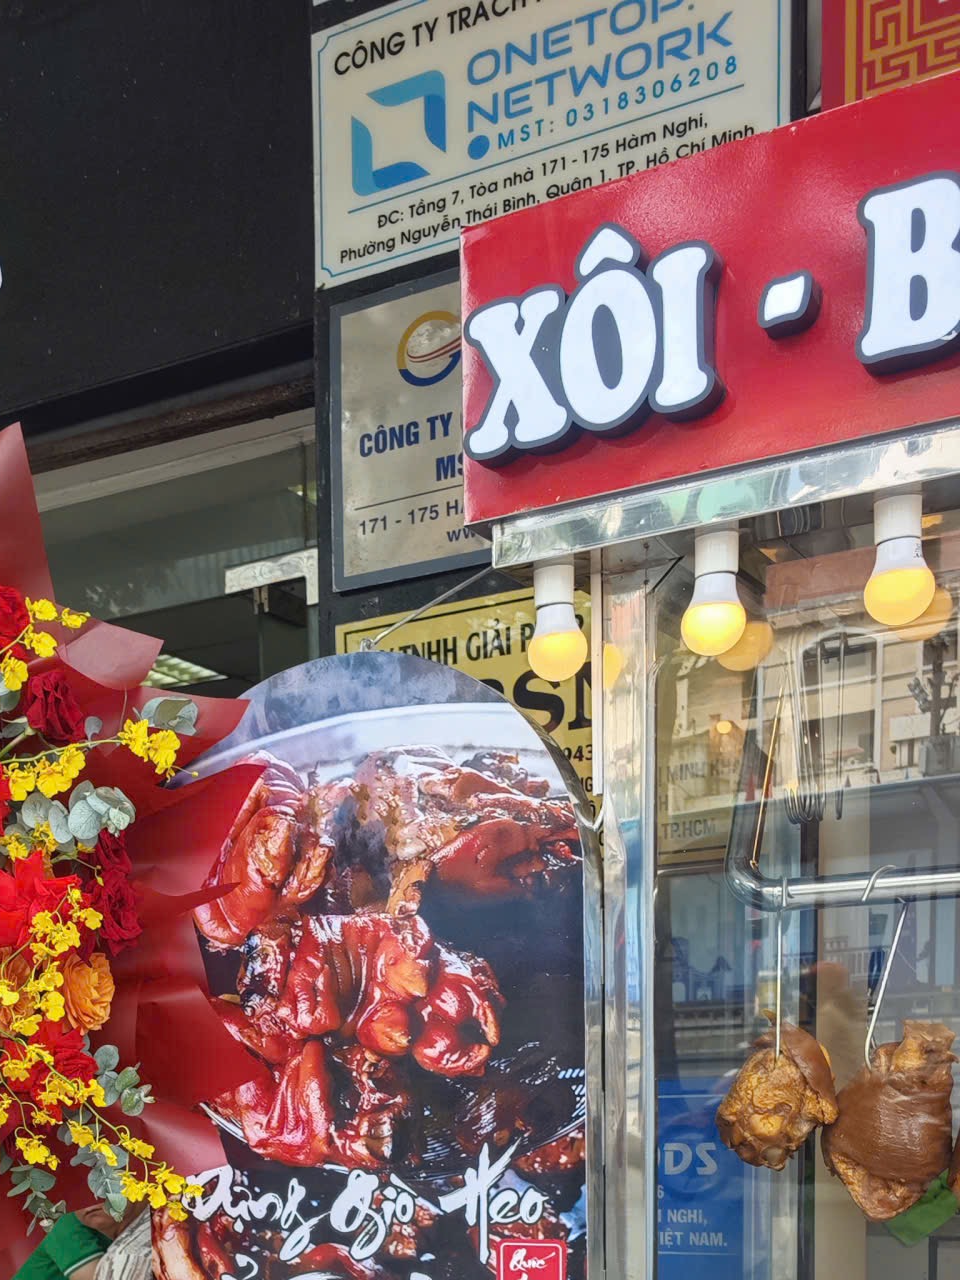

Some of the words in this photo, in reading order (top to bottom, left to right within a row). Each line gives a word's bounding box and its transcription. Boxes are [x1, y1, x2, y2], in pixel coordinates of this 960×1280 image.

[334, 31, 406, 76] CÔNG
[412, 17, 439, 48] TY
[467, 11, 733, 133] NETWORK
[566, 56, 738, 127] 0318306208
[339, 236, 396, 264] Phường
[400, 214, 461, 245] Nguyễn
[465, 206, 498, 226] Thái
[646, 147, 670, 170] Hồ
[676, 138, 707, 159] Chí
[711, 124, 755, 148] Minh
[377, 210, 404, 228] ĐC:
[408, 198, 447, 218] Tầng
[452, 190, 464, 205] 7,
[469, 181, 498, 199] Tòa
[503, 167, 534, 189] nhà
[541, 156, 566, 177] 171
[582, 142, 610, 164] 175
[615, 131, 657, 154] Hàm
[662, 112, 708, 140] Nghi,
[465, 223, 716, 464] XÔI
[359, 420, 420, 458] CÔNG
[426, 411, 453, 441] TY
[359, 515, 388, 535] 171
[407, 504, 439, 525] 175
[466, 618, 513, 662] GIẢI
[689, 1231, 728, 1248] NAM.
